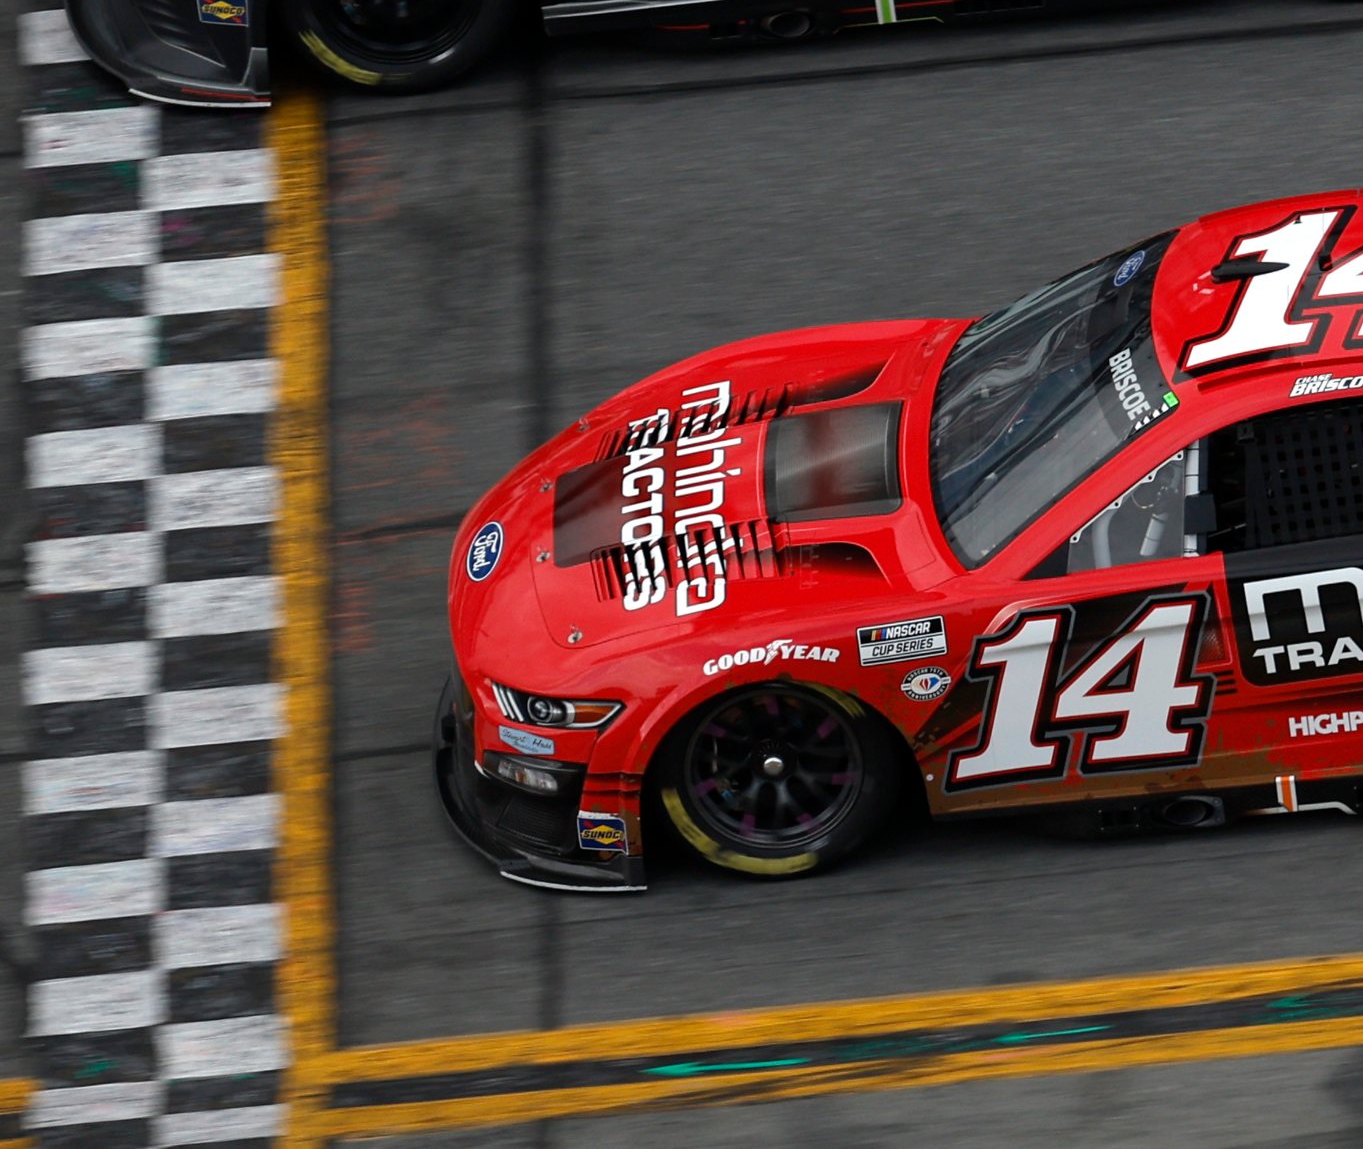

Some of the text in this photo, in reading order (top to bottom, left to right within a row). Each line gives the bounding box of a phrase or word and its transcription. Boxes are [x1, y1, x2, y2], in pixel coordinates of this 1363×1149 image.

[202, 3, 245, 17] SUNOCO
[1108, 348, 1152, 422] BRISCOE
[886, 621, 931, 640] NASCAR
[703, 639, 840, 676] GOODYEAR
[872, 638, 934, 657] CUP SERIES
[942, 591, 1216, 793] 14
